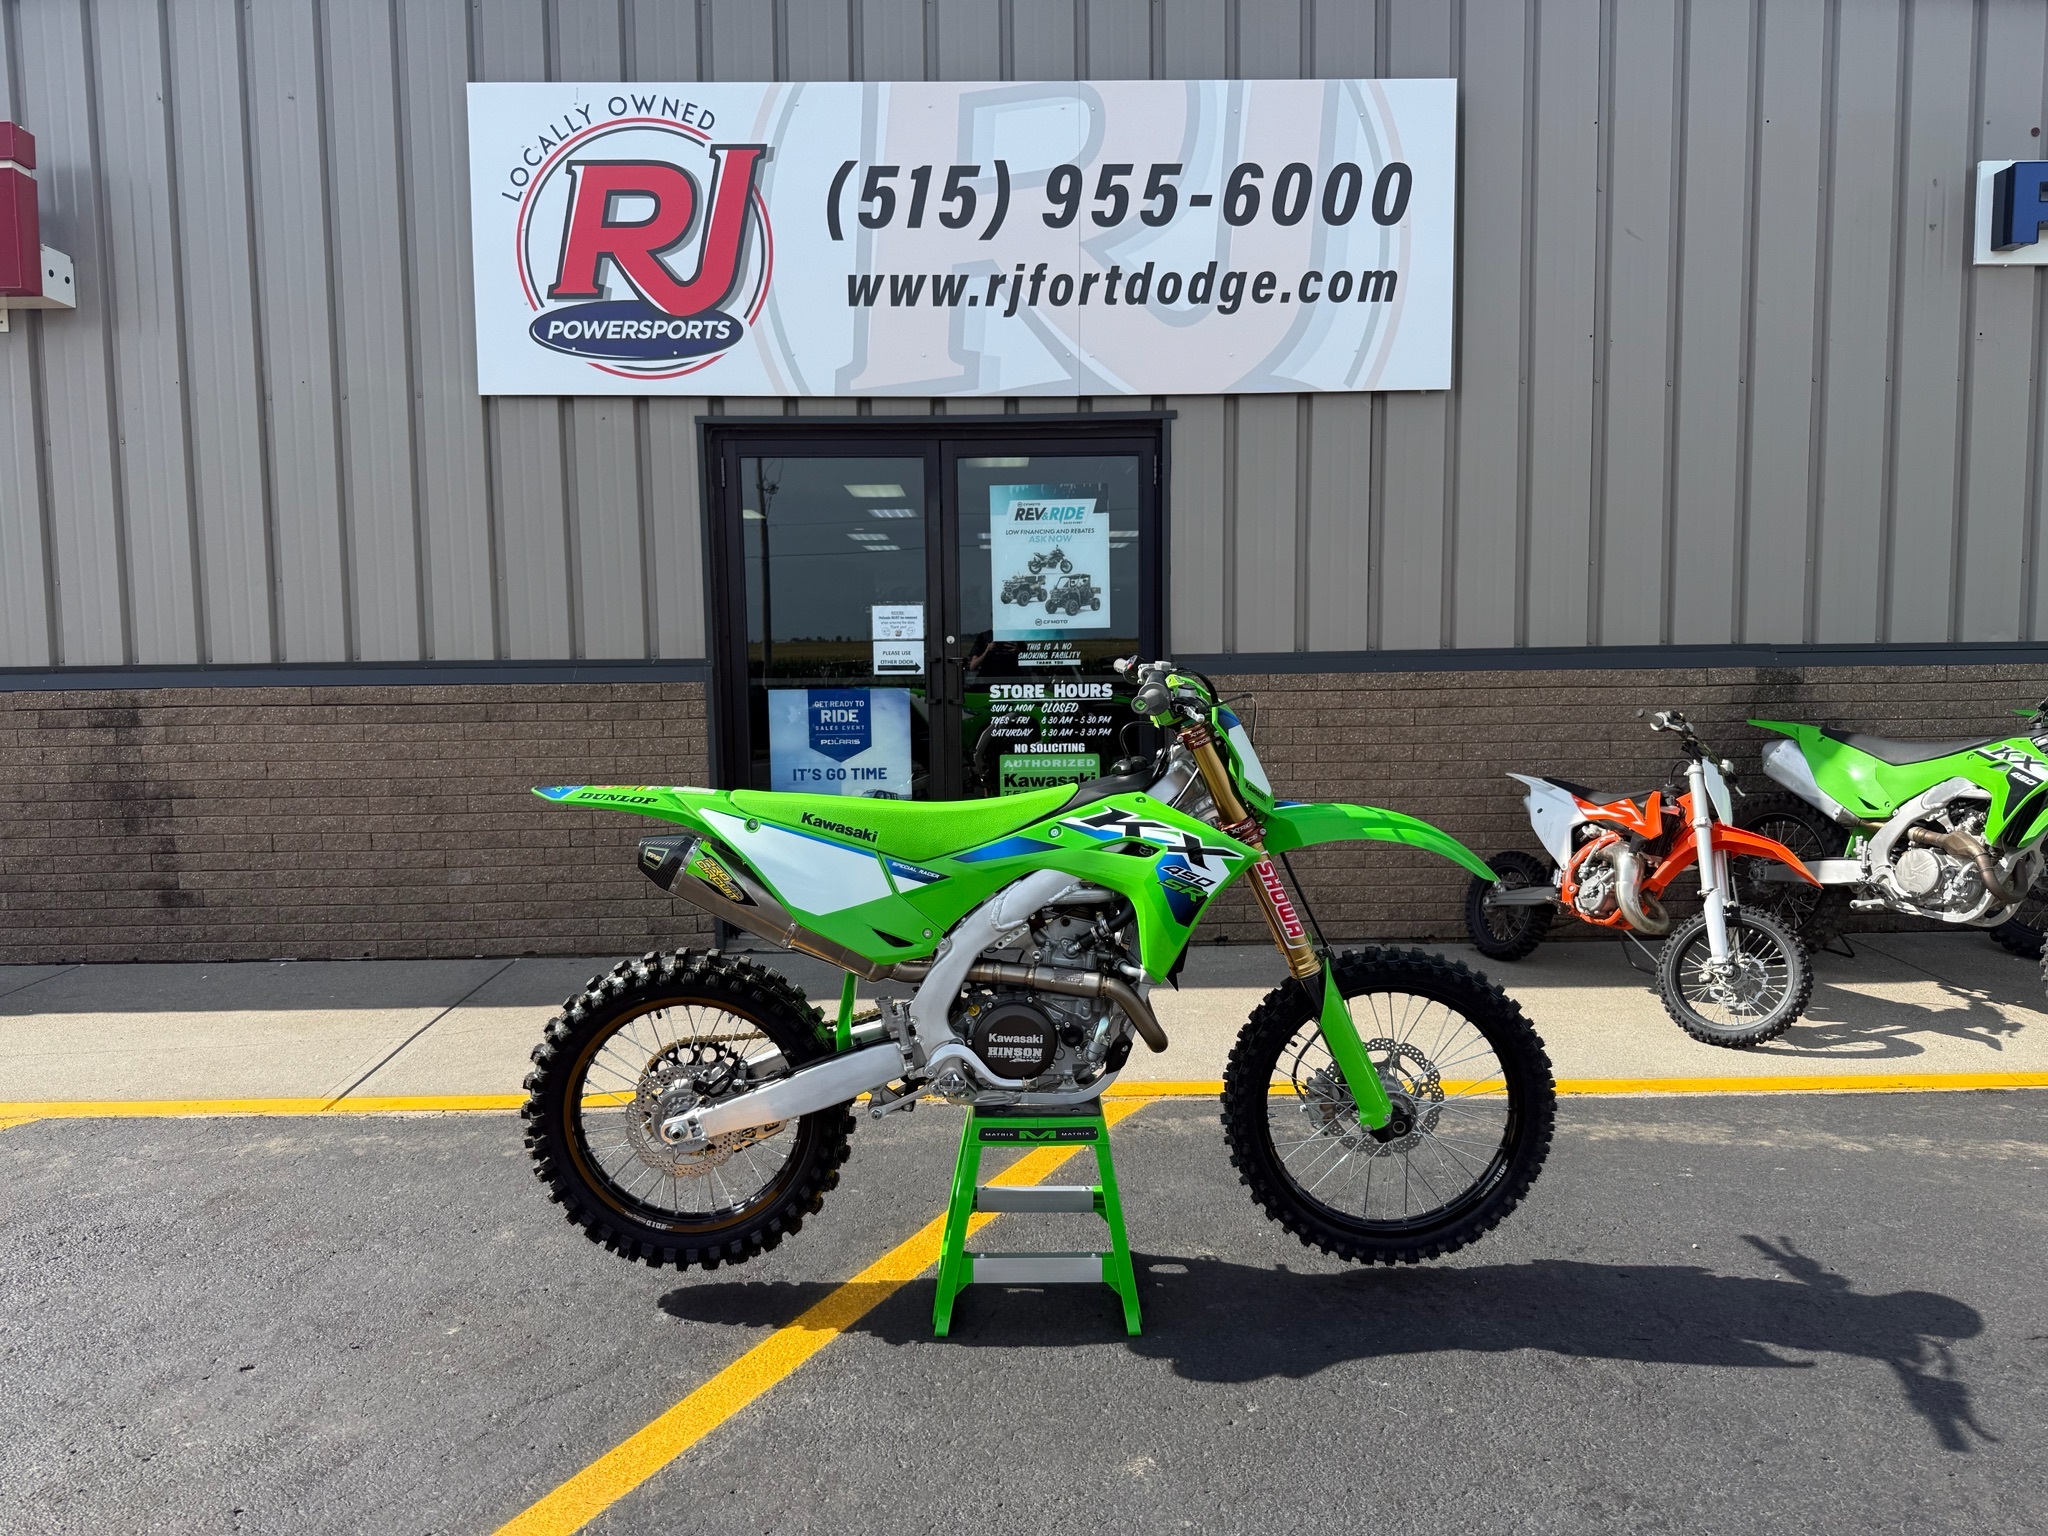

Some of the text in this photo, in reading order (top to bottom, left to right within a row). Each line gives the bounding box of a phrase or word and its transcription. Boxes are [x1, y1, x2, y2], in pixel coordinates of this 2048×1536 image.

[501, 94, 715, 202] LOCALLY OWNED
[827, 160, 1413, 241] (515) 955-6000
[548, 143, 770, 316] RJ
[847, 261, 1397, 317] www.rjfortdodge.com
[547, 319, 731, 340] POWERSPORTS
[1028, 535, 1047, 543] ASK
[1018, 651, 1081, 660] SMOKING FACILITY
[989, 683, 1113, 698] STORE HOURS
[814, 700, 829, 708] GET
[991, 704, 1008, 712] SUN
[1014, 704, 1035, 712] MON
[1041, 702, 1079, 713] CLOSED
[820, 709, 859, 723] RIDE
[991, 716, 1010, 724] TUES
[1016, 716, 1031, 724] FRI
[1058, 716, 1073, 724] AM
[991, 728, 1034, 737] SATURDAY
[1058, 728, 1073, 736] AM
[1097, 728, 1112, 736] PM
[1014, 743, 1085, 753] NO SOLICITING
[1003, 759, 1096, 768] AUTHORIZED
[792, 767, 888, 781] IT'S GO TIME
[2010, 771, 2039, 786] 450
[578, 792, 658, 804] DUNLOP
[1245, 781, 1267, 802] Kawasaki
[801, 812, 878, 843] Kawasaki
[1230, 821, 1253, 834] XTRIG
[703, 857, 732, 882] PRO
[892, 861, 940, 879] SPECIAL RACER
[1160, 865, 1216, 887] 450
[695, 859, 740, 901] CIRCUIT
[1157, 879, 1209, 903] SR
[1255, 860, 1304, 938] SHOWA
[988, 1033, 1044, 1044] Kawasaki
[988, 1047, 1043, 1057] HINSON
